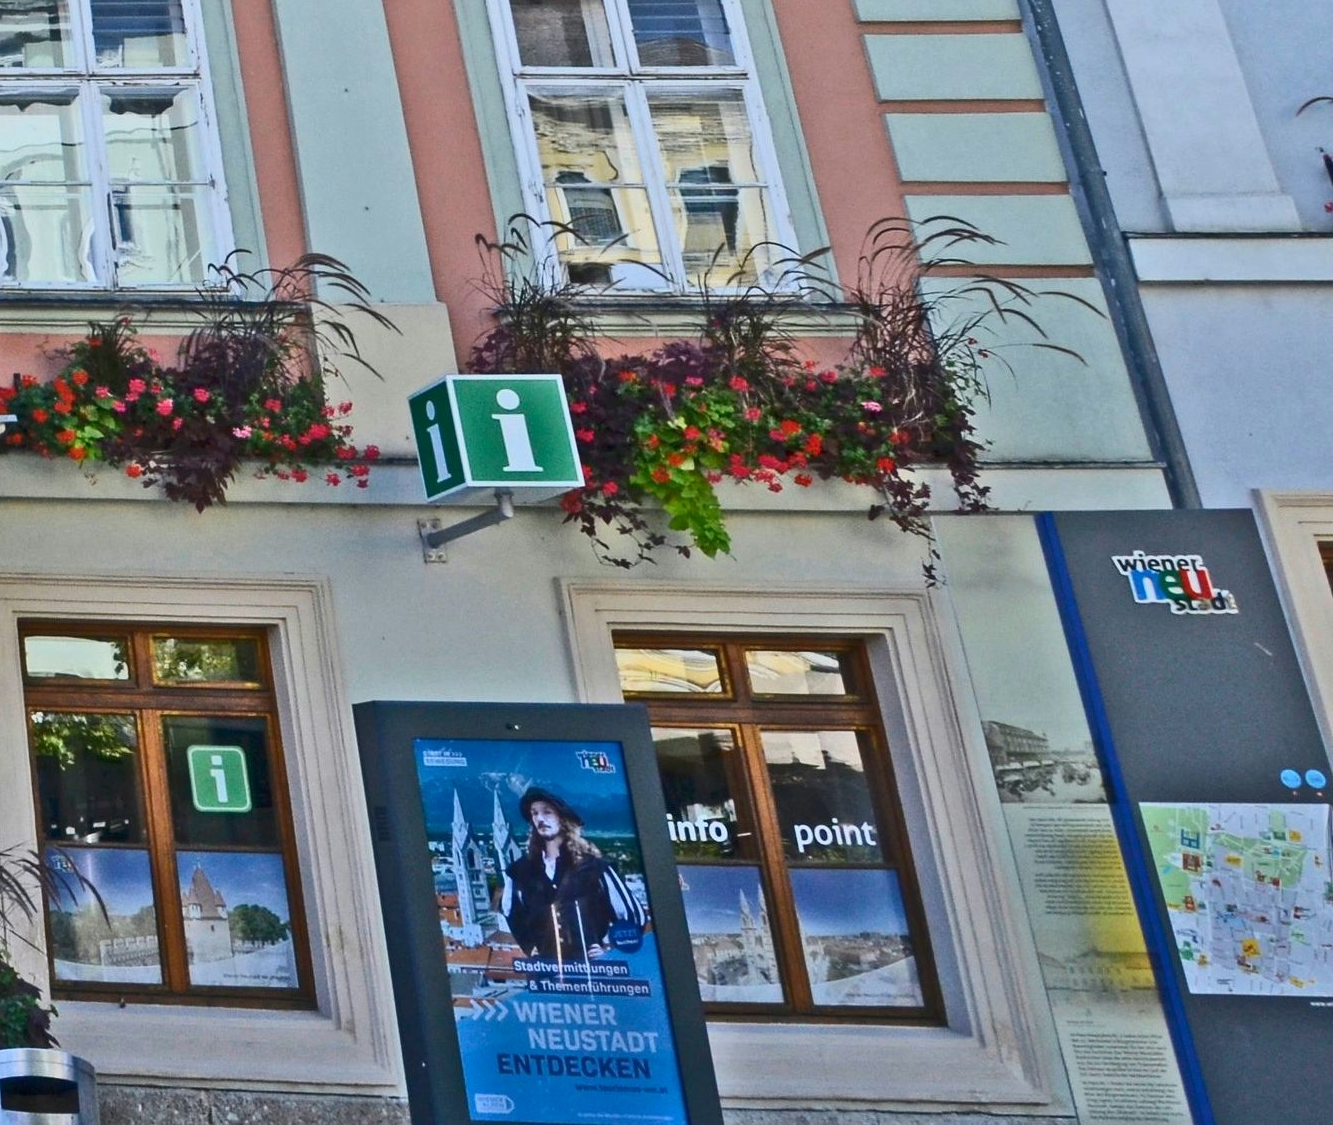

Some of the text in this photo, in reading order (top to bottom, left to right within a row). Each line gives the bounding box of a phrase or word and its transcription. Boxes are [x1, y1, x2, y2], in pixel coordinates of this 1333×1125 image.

[1116, 554, 1200, 572] wiener
[1130, 569, 1212, 600] neu
[666, 813, 728, 843] info
[794, 817, 877, 853] point
[529, 980, 539, 991] &
[513, 1001, 617, 1025] WIENER
[528, 1028, 659, 1053] NEUSTADT
[497, 1053, 652, 1079] ENTDECKEN
